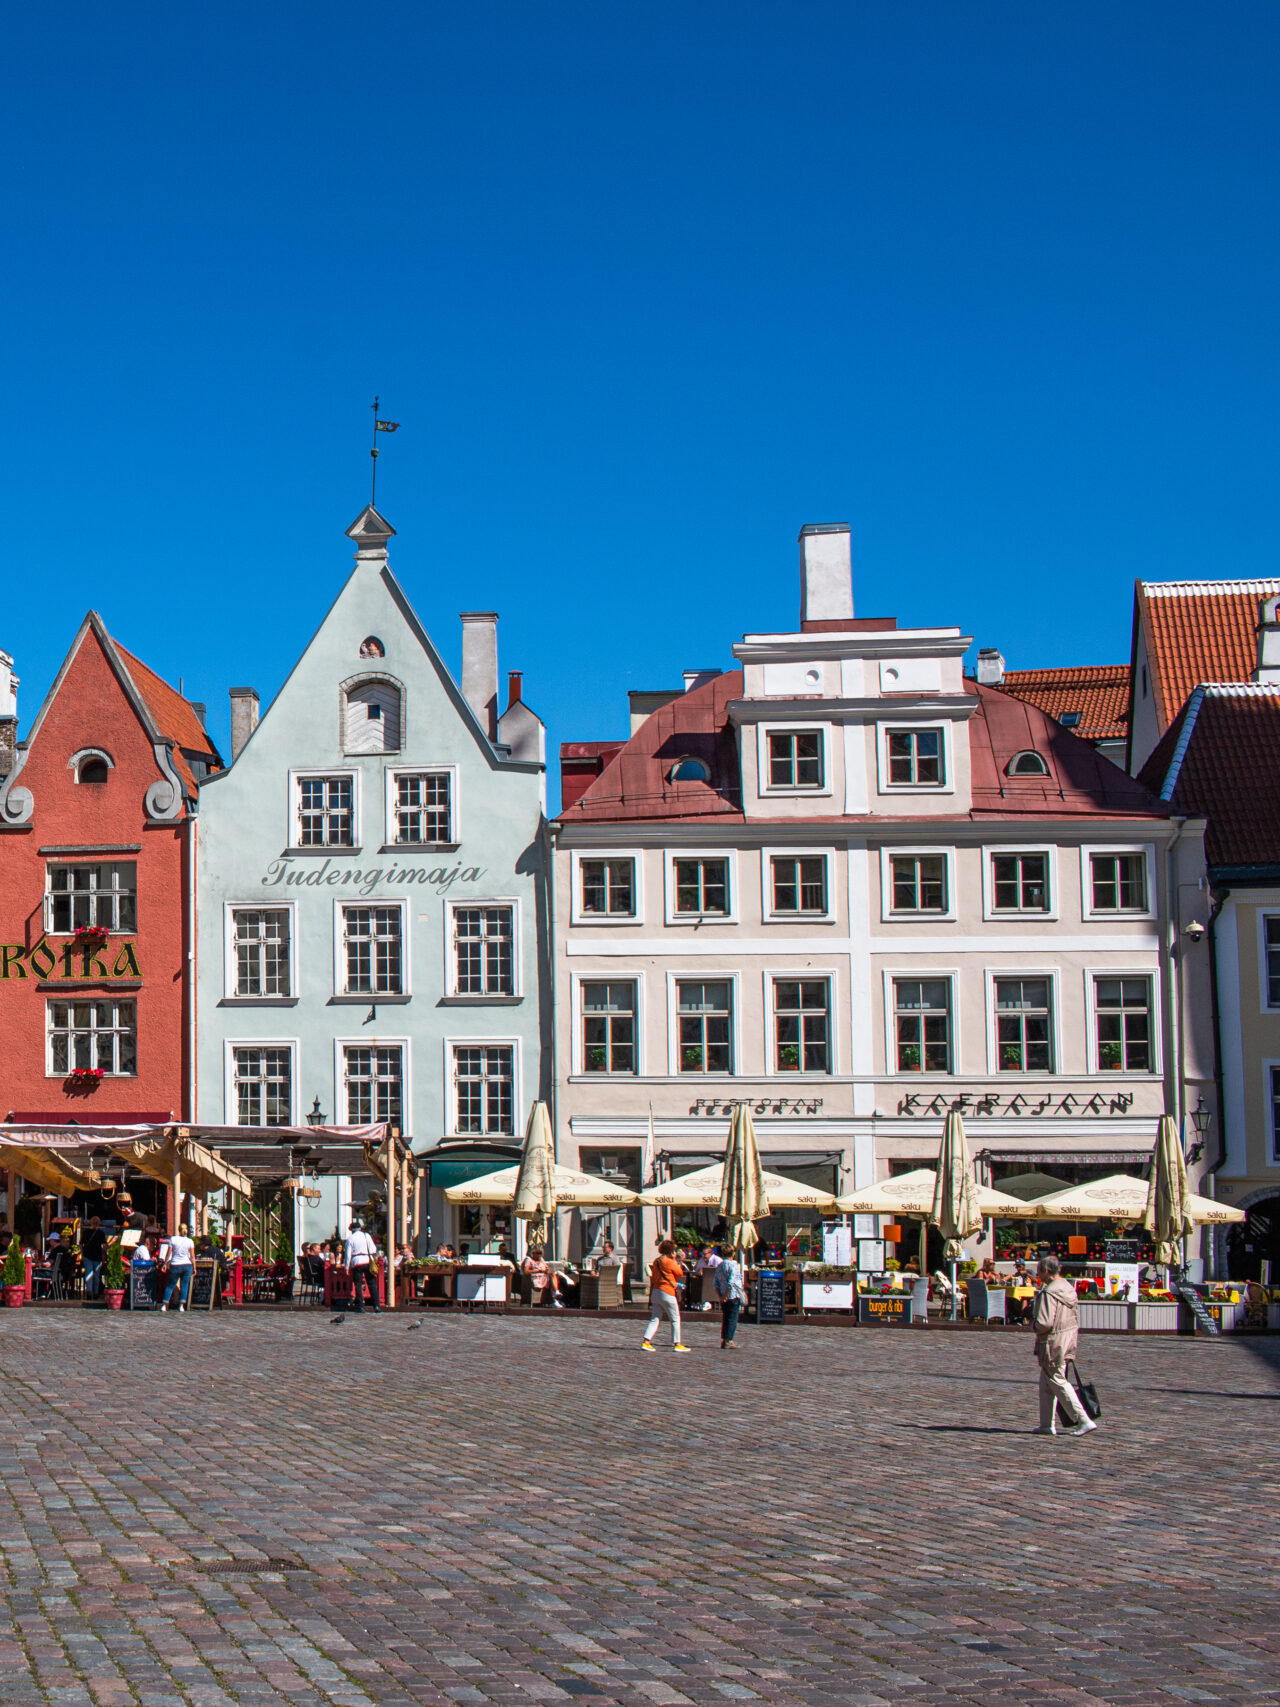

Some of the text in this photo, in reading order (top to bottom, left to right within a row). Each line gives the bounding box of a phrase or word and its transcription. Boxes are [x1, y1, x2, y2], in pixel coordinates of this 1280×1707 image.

[261, 858, 488, 896] Tudengimaja
[905, 1093, 1133, 1107] KAERAJAAN
[869, 1298, 887, 1317] burger
[888, 1299, 894, 1313] &
